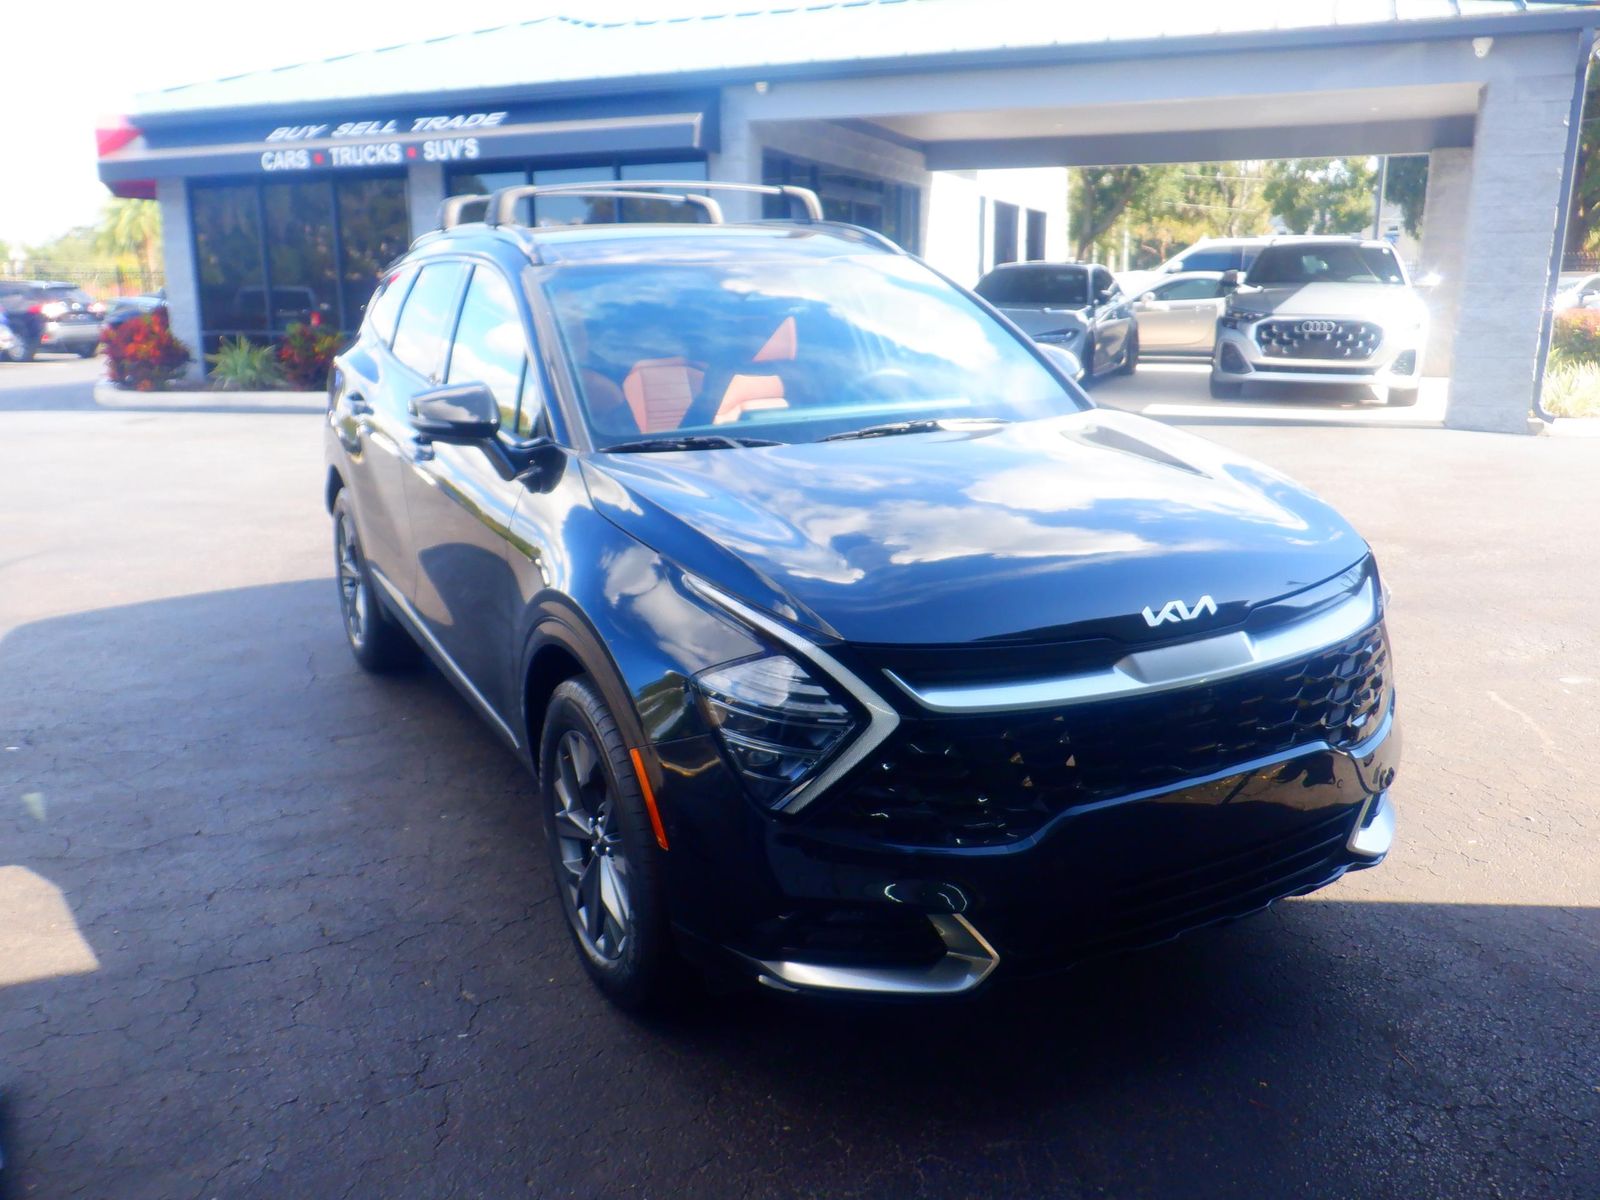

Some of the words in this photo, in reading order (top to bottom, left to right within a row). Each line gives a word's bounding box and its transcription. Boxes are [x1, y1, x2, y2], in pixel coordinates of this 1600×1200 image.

[265, 124, 328, 141] BUY
[331, 120, 398, 137] SELL
[410, 112, 508, 131] TRADE
[261, 149, 311, 171] CARS
[329, 143, 403, 167] TRUCKS
[423, 138, 480, 161] SUV'S
